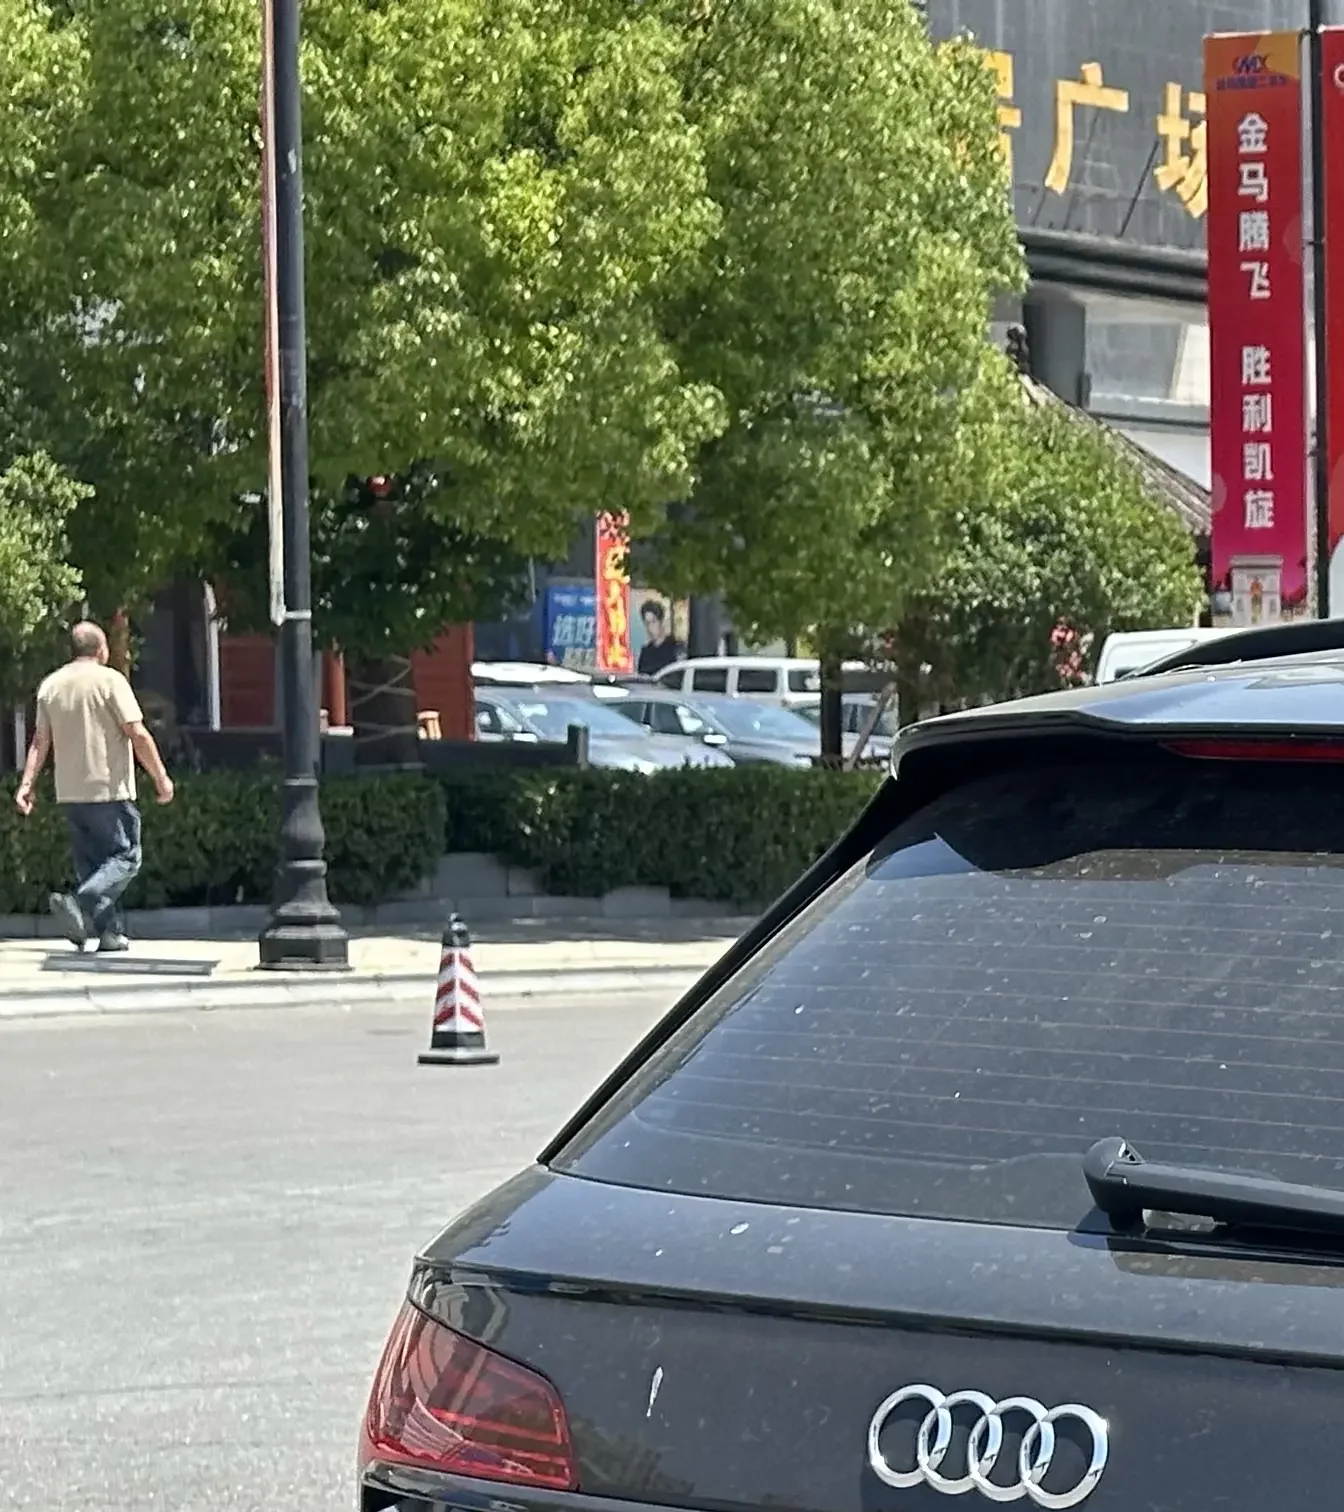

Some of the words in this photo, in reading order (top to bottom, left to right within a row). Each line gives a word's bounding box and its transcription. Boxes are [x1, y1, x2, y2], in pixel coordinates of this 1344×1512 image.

[1238, 112, 1271, 300] 金马腾飞
[1242, 344, 1275, 528] 胜利凯旋
